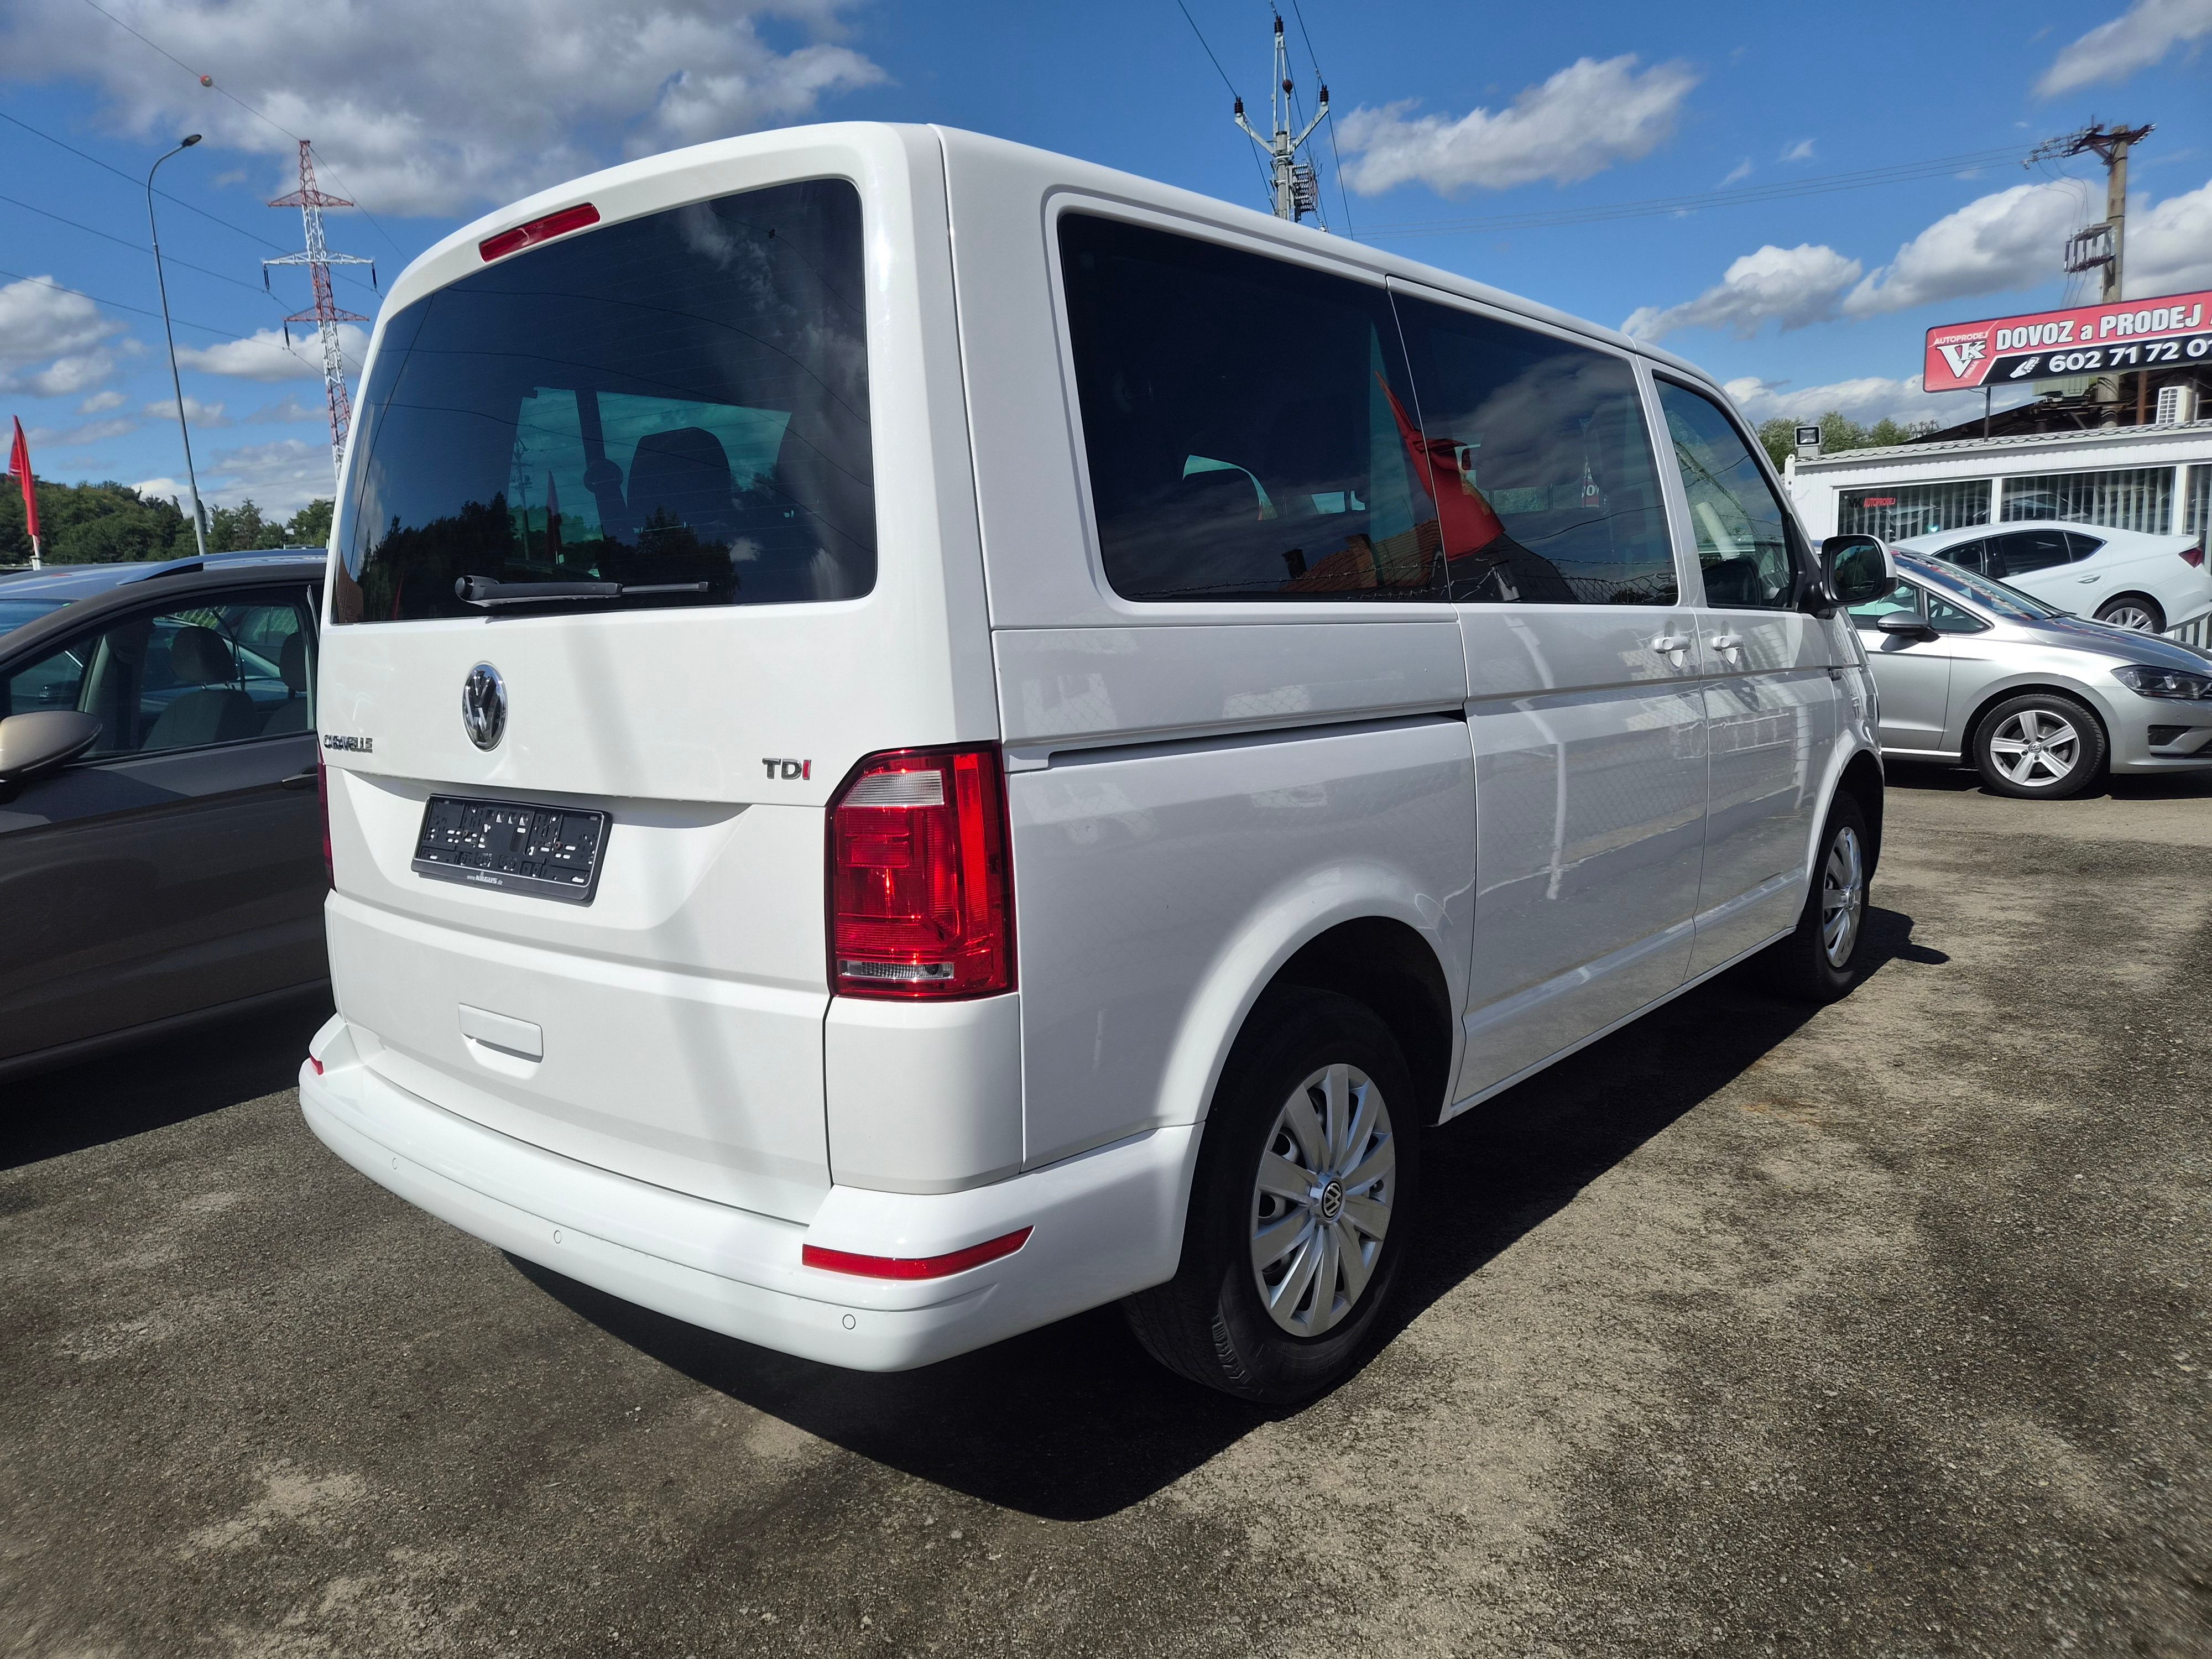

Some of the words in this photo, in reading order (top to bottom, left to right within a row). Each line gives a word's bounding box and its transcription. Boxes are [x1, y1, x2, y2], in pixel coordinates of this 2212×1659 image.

[1996, 320, 2074, 351] DOVOZ
[2080, 325, 2093, 341] a
[2099, 304, 2201, 338] PRODEJ
[1934, 331, 1989, 345] AUTOPRODEJ
[1936, 340, 1986, 378] VK
[2049, 351, 2101, 373] 602
[2109, 346, 2138, 366] 71
[2146, 342, 2179, 362] 72
[2187, 338, 2212, 357] 0
[1963, 361, 1980, 378] FIRMA
[1863, 497, 1896, 508] AUTOPRODEJ
[324, 734, 373, 753] CARAVELLE
[761, 758, 811, 780] TDI
